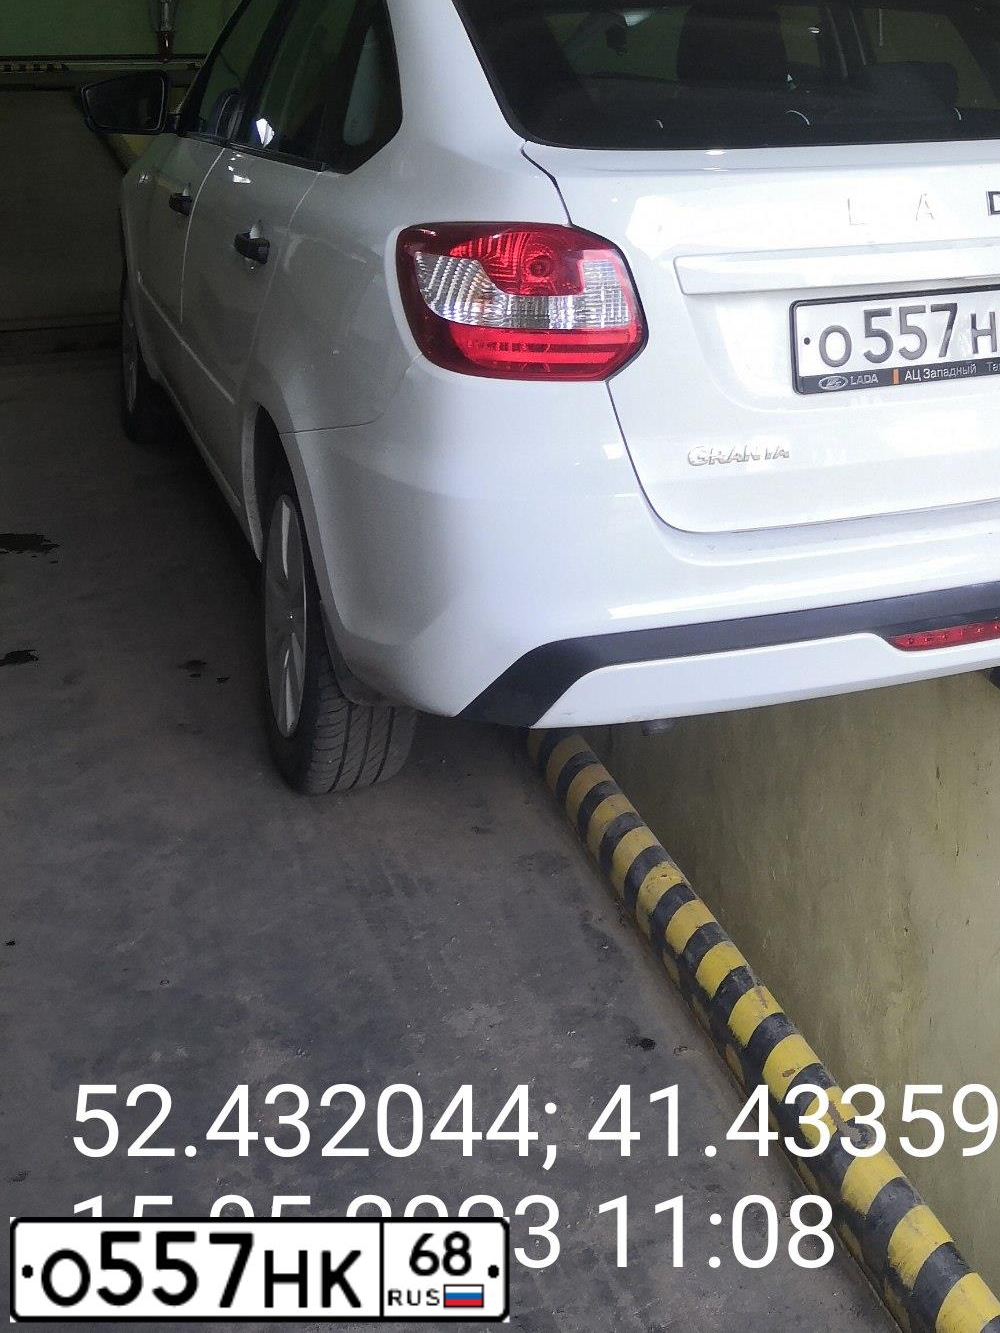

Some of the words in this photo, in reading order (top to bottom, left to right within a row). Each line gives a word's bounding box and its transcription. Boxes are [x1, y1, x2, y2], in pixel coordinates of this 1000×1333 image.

[850, 373, 879, 385] LADA
[904, 370, 922, 382] АЦ
[923, 363, 978, 379] Западный
